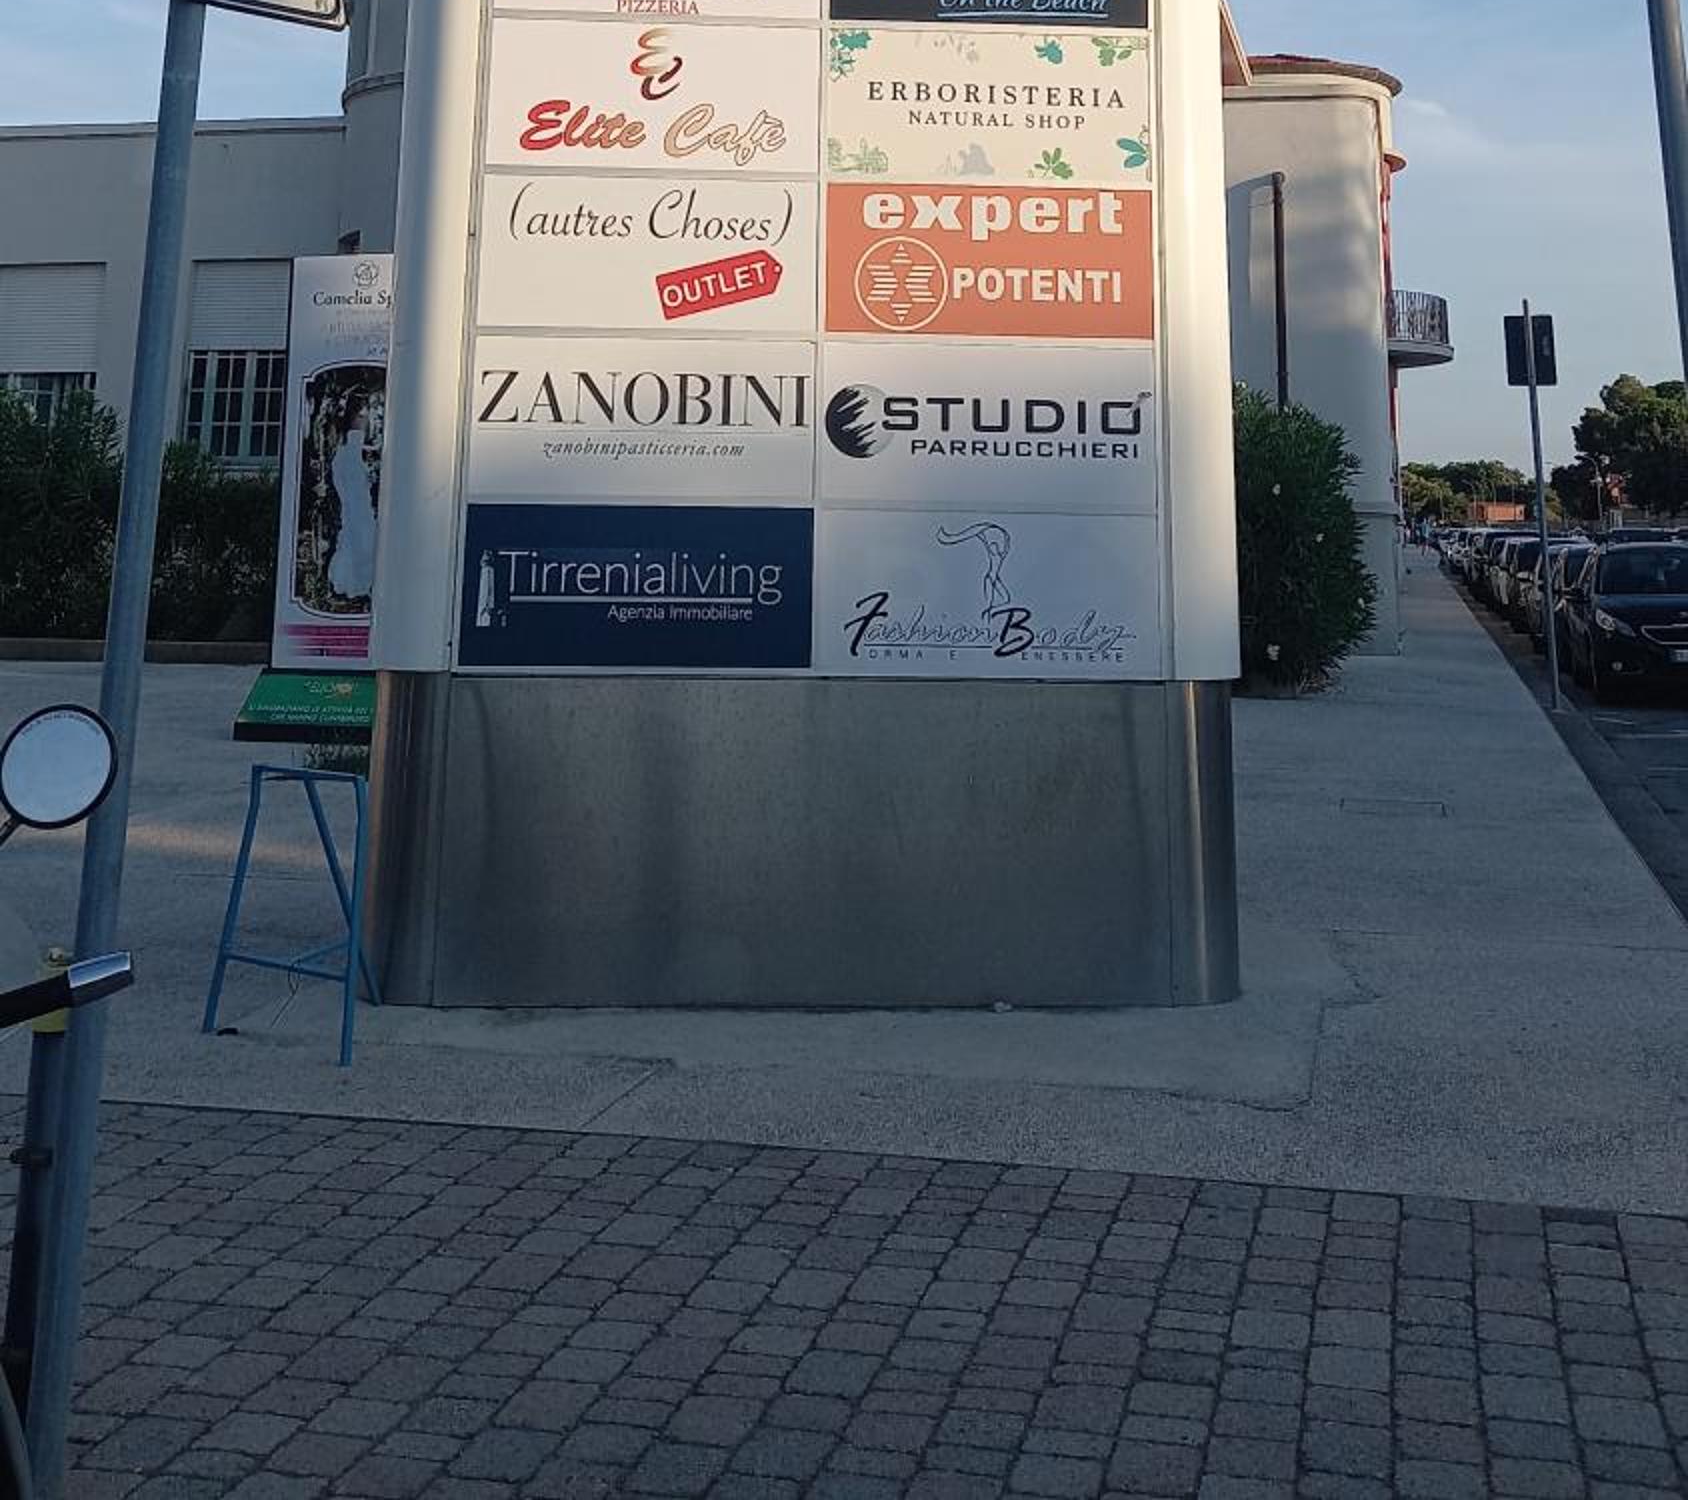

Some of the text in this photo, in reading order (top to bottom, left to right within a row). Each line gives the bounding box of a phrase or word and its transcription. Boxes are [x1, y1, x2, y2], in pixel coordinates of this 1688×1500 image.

[868, 81, 1127, 109] ERBORISTERIA
[520, 99, 646, 150] Elite
[908, 110, 1086, 129] NATURAL SHOP
[510, 182, 793, 246] (autres Choses)
[863, 191, 1123, 241] expert
[313, 290, 372, 305] Camelia
[662, 261, 768, 307] OUTLET
[952, 267, 1121, 303] POTENTI
[478, 370, 810, 427] ZANOBINI
[882, 391, 1152, 435] STUDIO
[911, 439, 1138, 459] PARRUCCHIERI
[498, 550, 784, 605] Tirrenialiving
[608, 605, 753, 623] Agenzia Immobiliare
